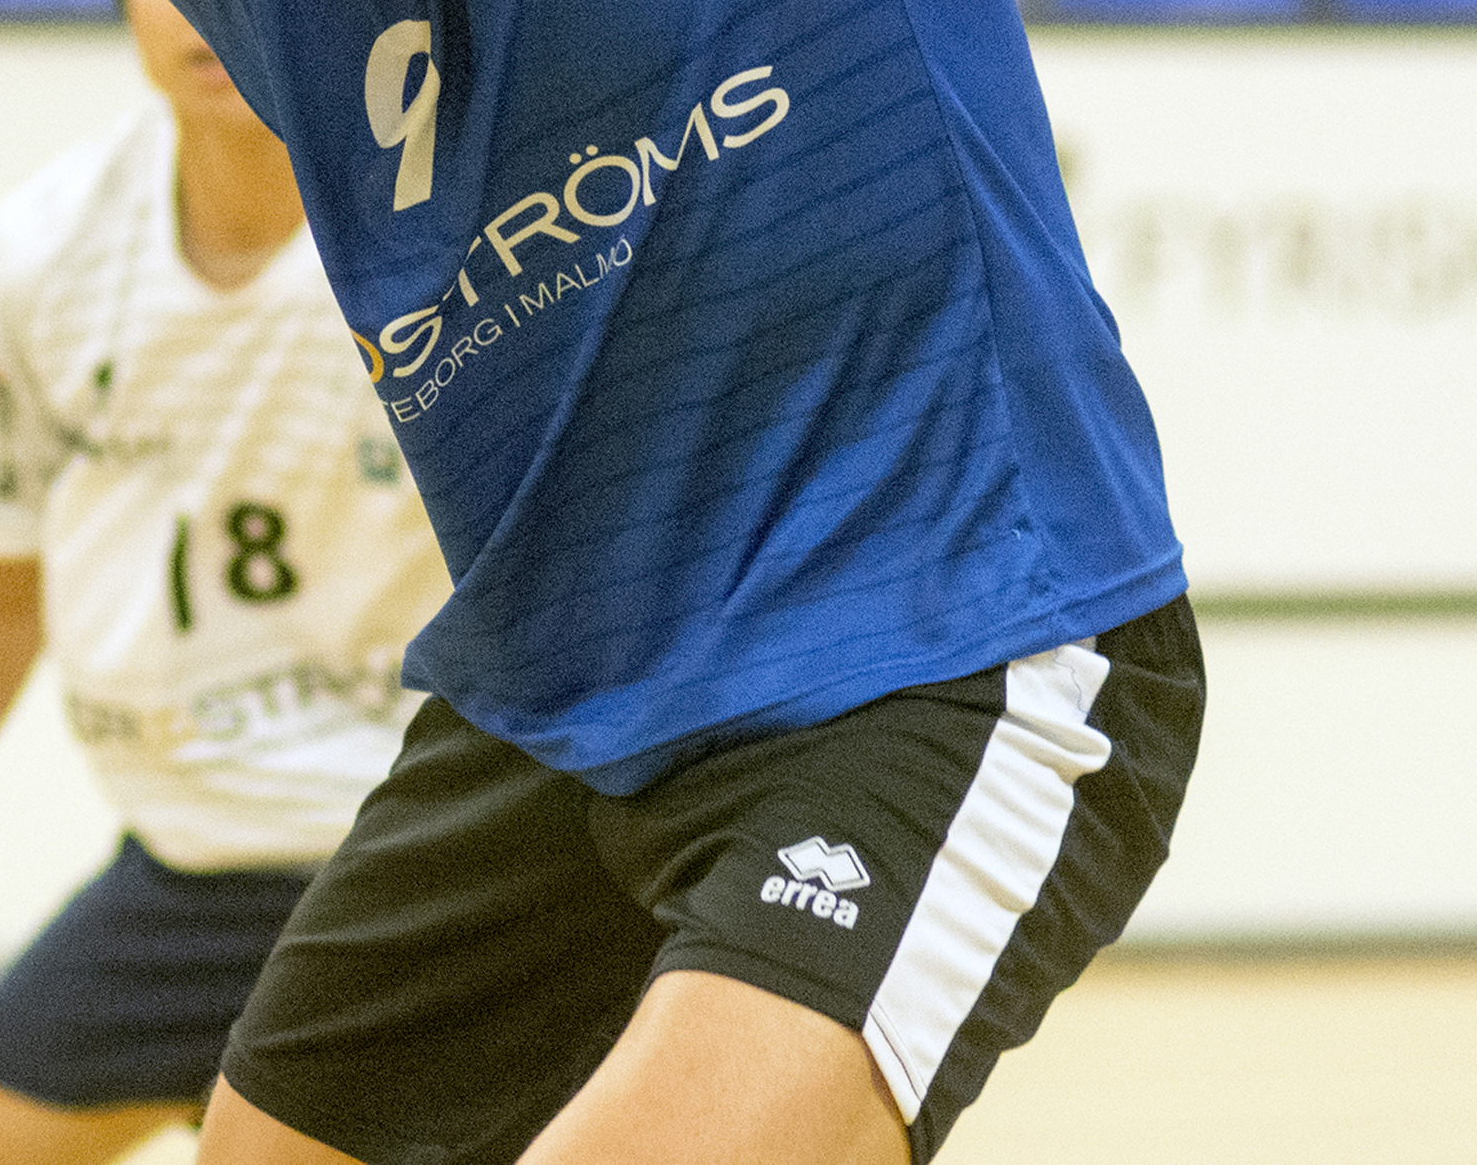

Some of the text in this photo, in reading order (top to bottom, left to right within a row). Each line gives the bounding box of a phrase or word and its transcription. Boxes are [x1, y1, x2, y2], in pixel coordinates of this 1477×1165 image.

[364, 19, 441, 212] 9
[382, 318, 503, 424] EBORG
[167, 502, 298, 634] 18
[760, 875, 859, 930] errea
